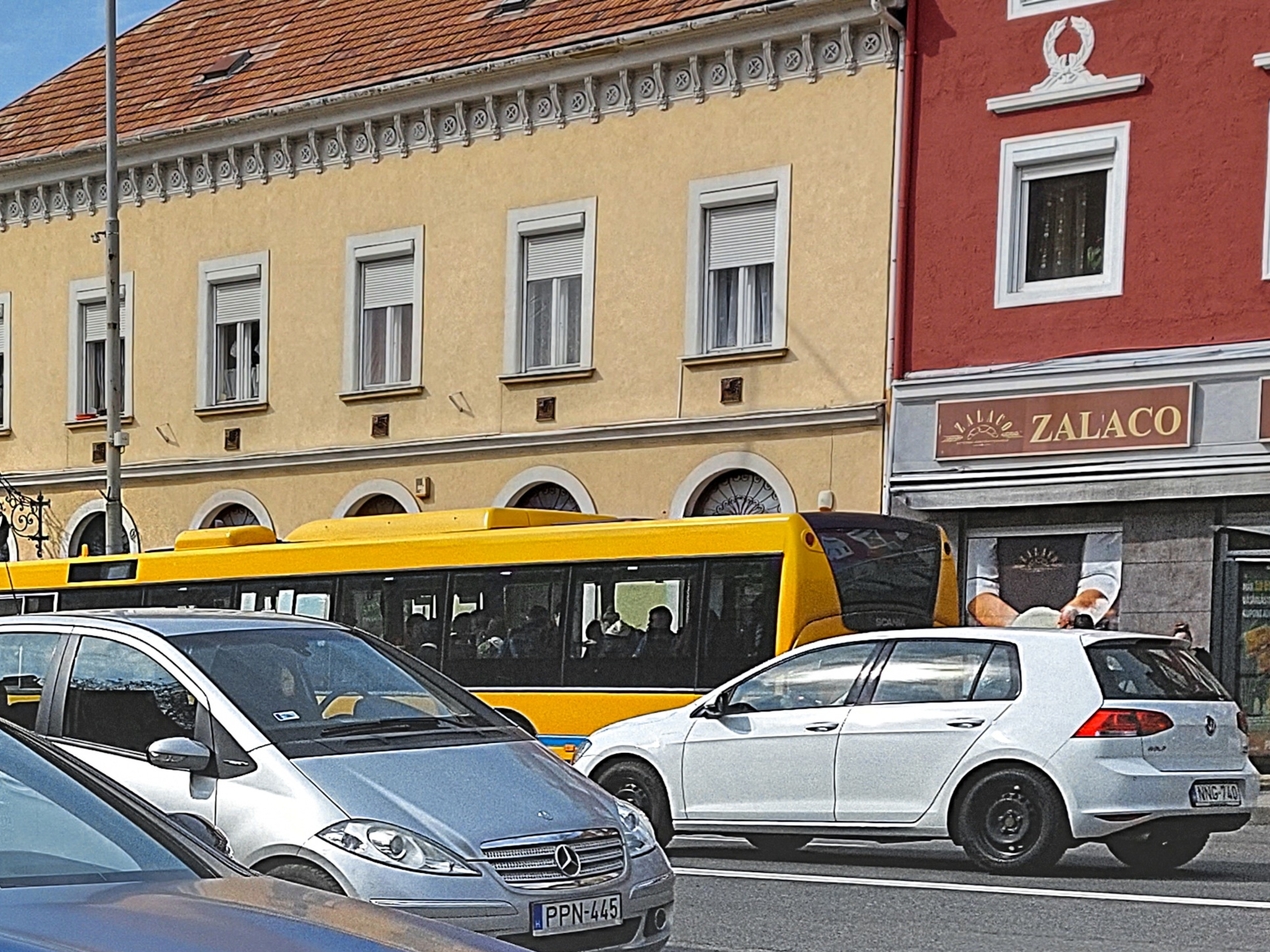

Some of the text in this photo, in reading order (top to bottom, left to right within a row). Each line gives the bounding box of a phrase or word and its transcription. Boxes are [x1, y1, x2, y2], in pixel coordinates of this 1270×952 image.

[1030, 406, 1182, 443] ZALACO
[1196, 783, 1239, 801] NNG-740
[546, 897, 618, 928] PPN-445
